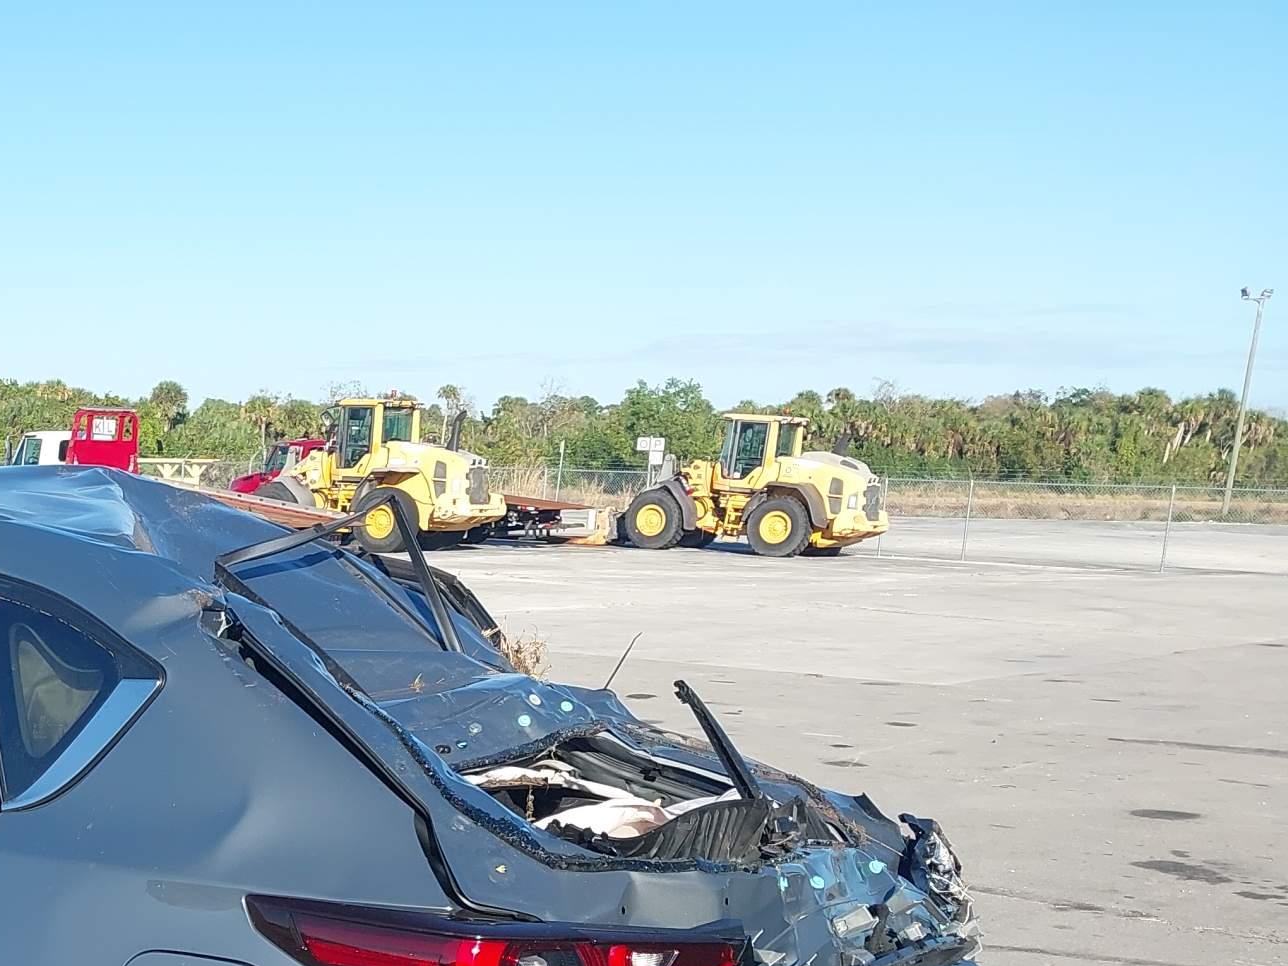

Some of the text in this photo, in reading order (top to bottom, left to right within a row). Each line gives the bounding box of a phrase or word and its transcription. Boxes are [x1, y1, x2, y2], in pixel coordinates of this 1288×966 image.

[94, 420, 113, 433] K L
[654, 440, 662, 449] P
